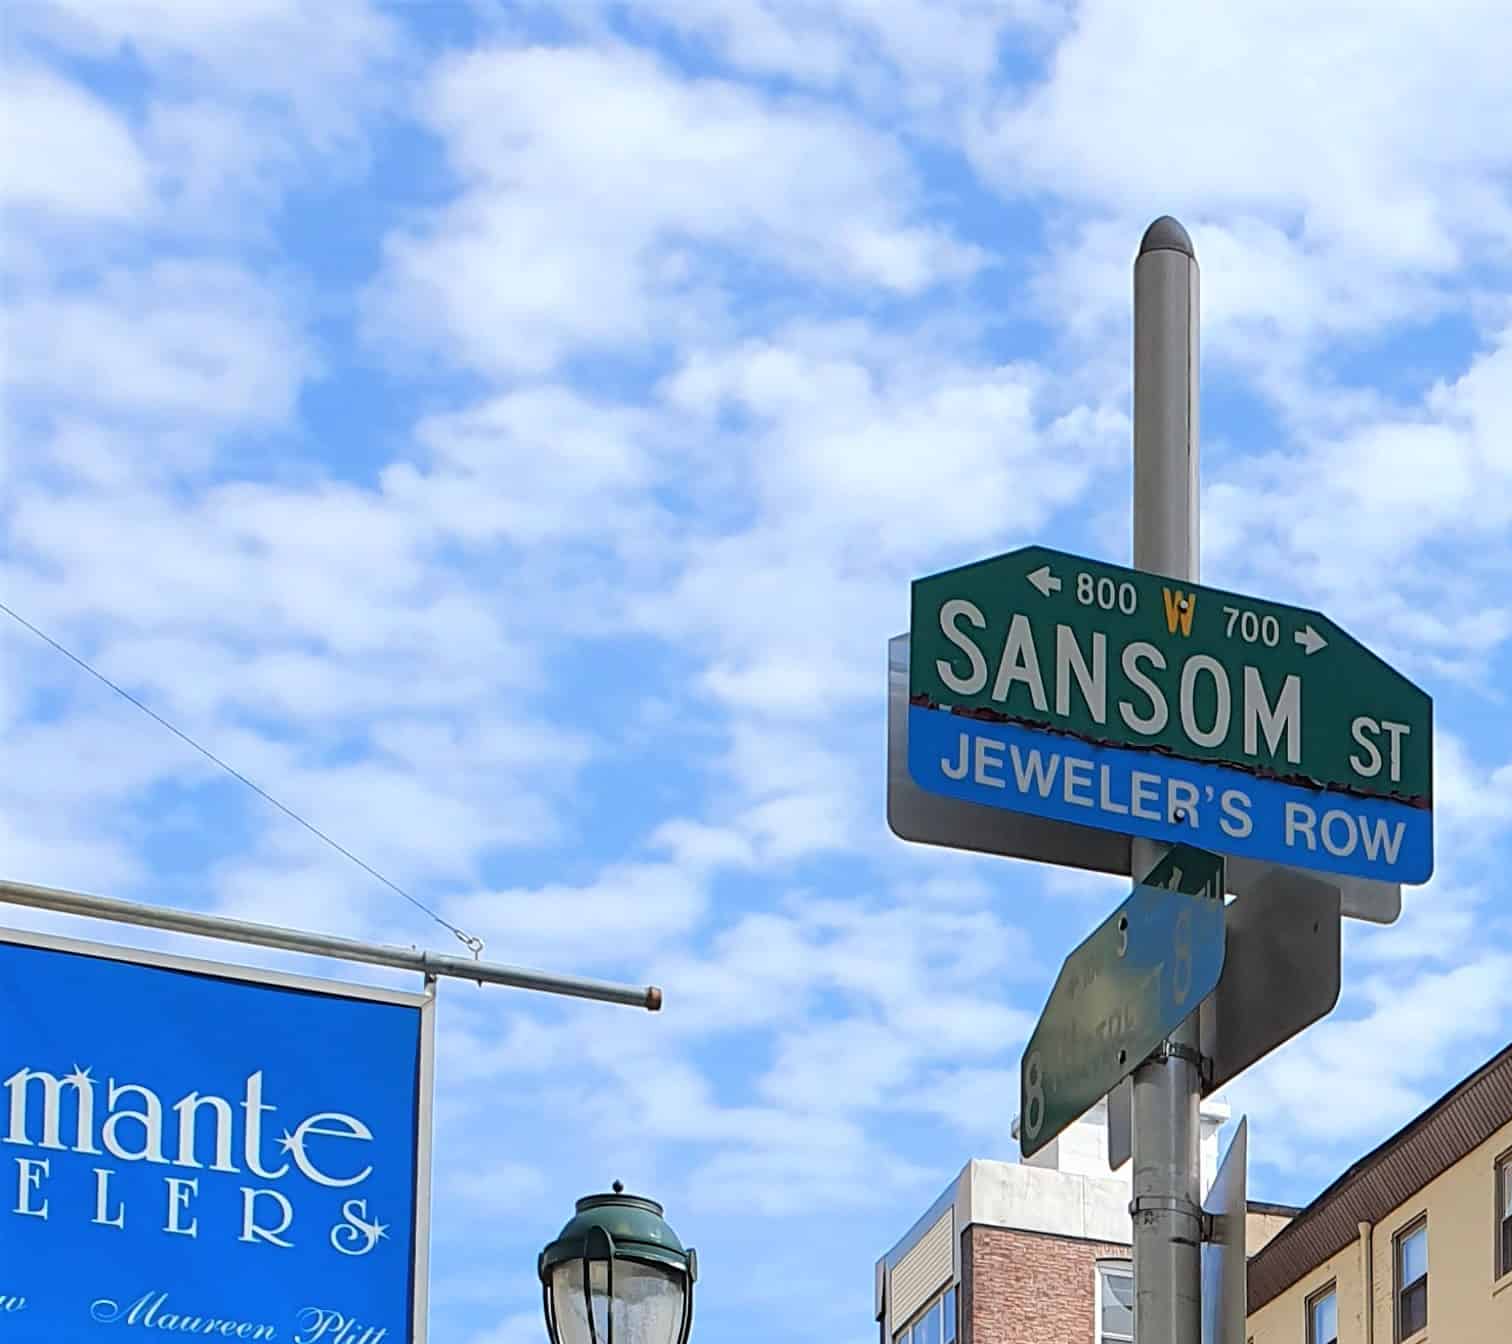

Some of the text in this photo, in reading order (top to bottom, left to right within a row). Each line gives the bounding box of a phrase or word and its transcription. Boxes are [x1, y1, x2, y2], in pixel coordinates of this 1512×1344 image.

[1076, 572, 1279, 647] 800 W 700
[936, 599, 1301, 764] SANSOM
[1349, 716, 1410, 781] ST
[941, 733, 1407, 866] JEWELER'S ROW
[3, 1064, 375, 1188] mante
[13, 1157, 380, 1256] ELERS
[90, 1291, 278, 1342] Maureen
